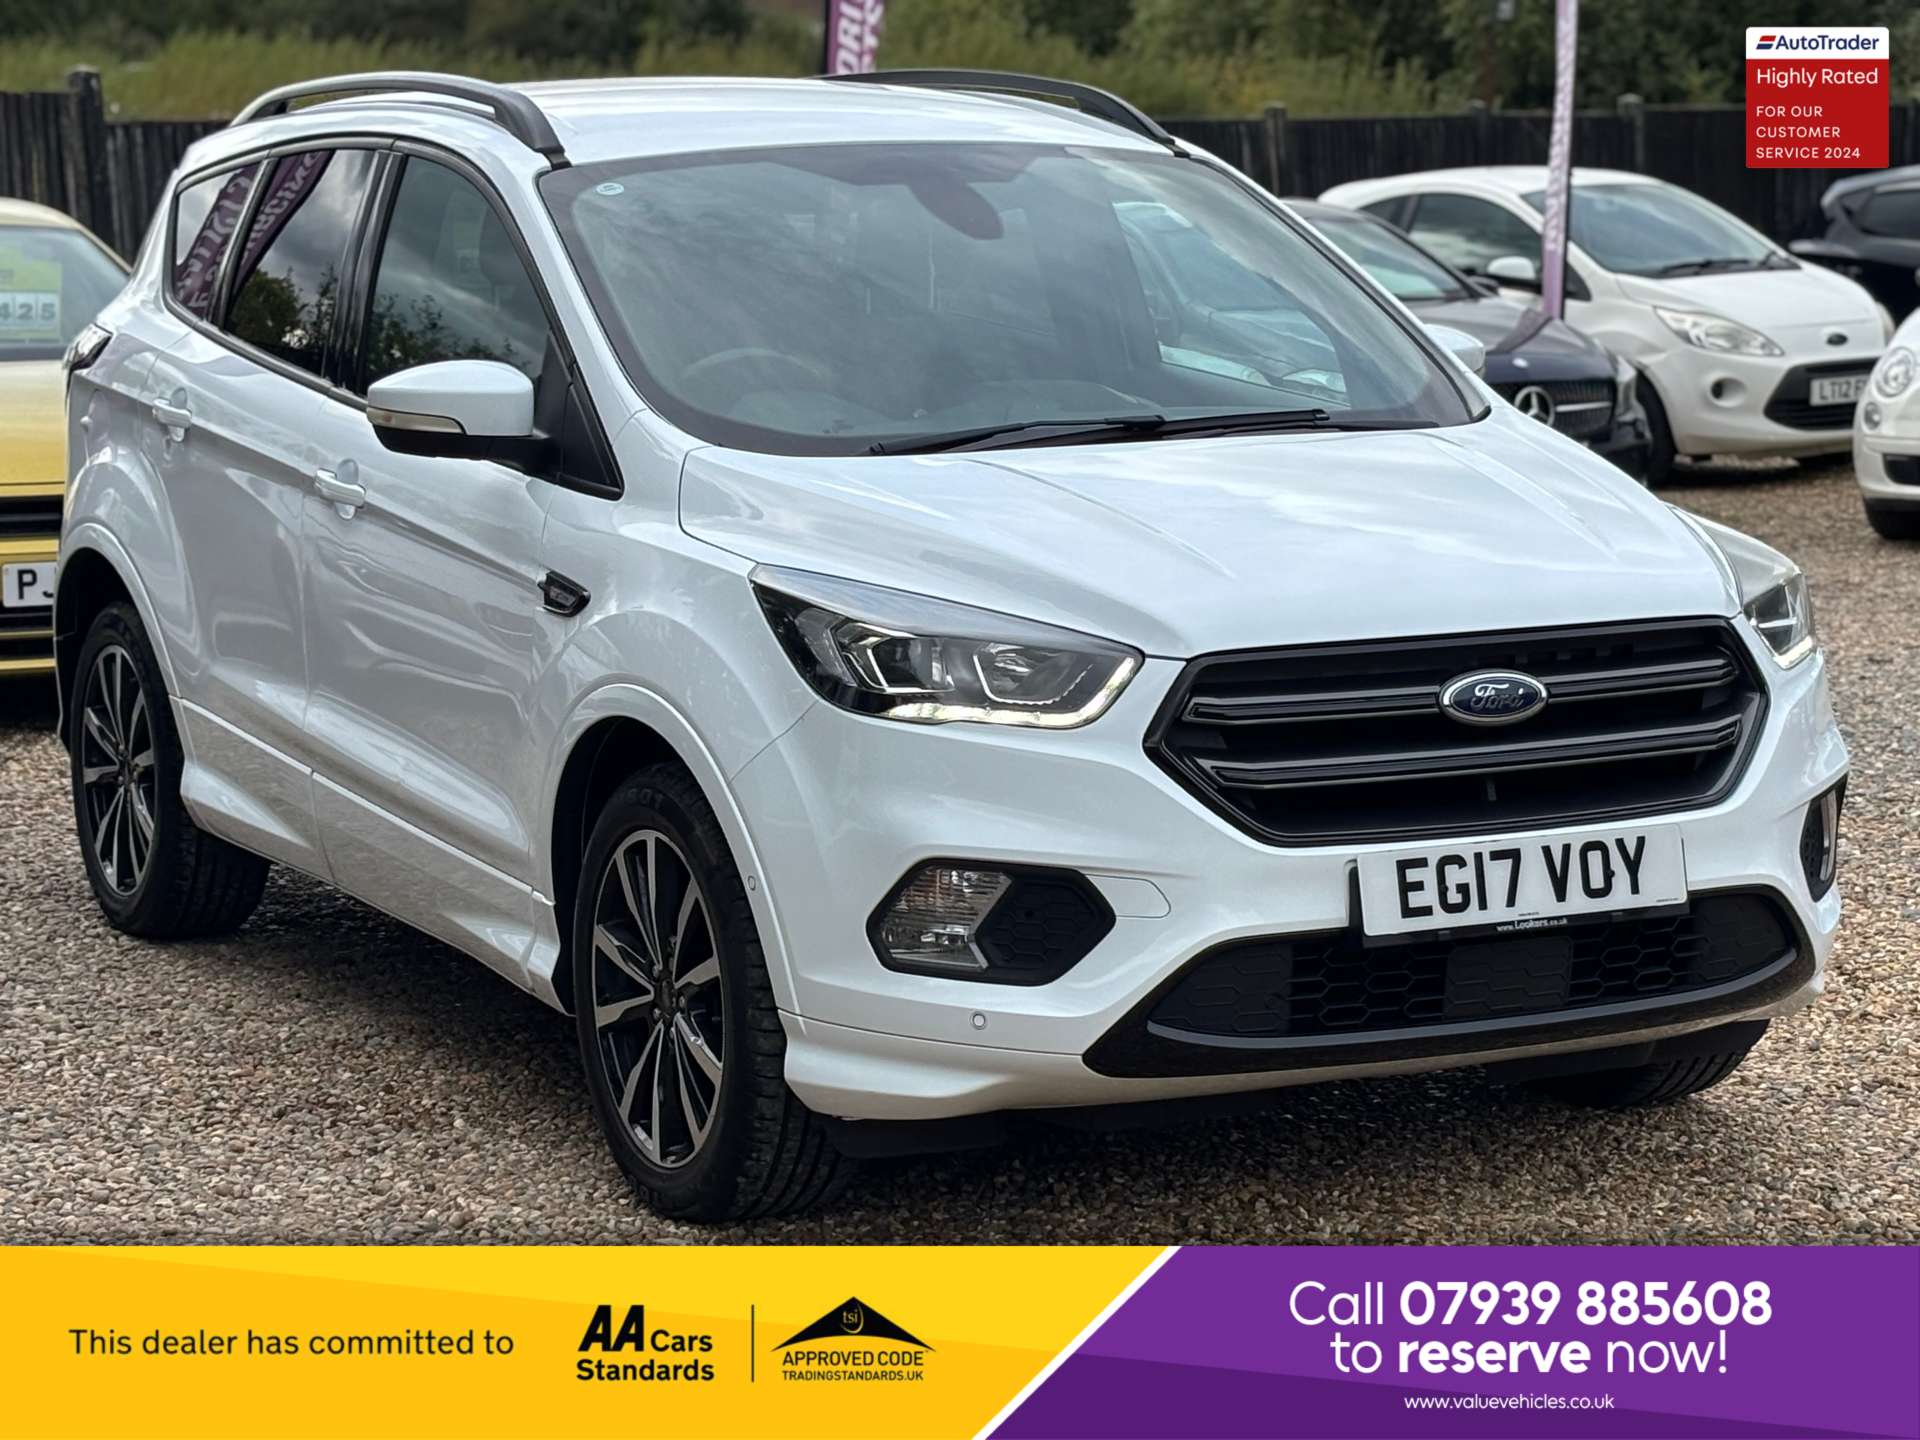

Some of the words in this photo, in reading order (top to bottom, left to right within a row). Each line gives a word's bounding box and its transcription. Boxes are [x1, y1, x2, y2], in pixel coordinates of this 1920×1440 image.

[1469, 682, 1525, 710] Ford
[1396, 848, 1521, 919] EG17
[1540, 835, 1646, 903] VOY
